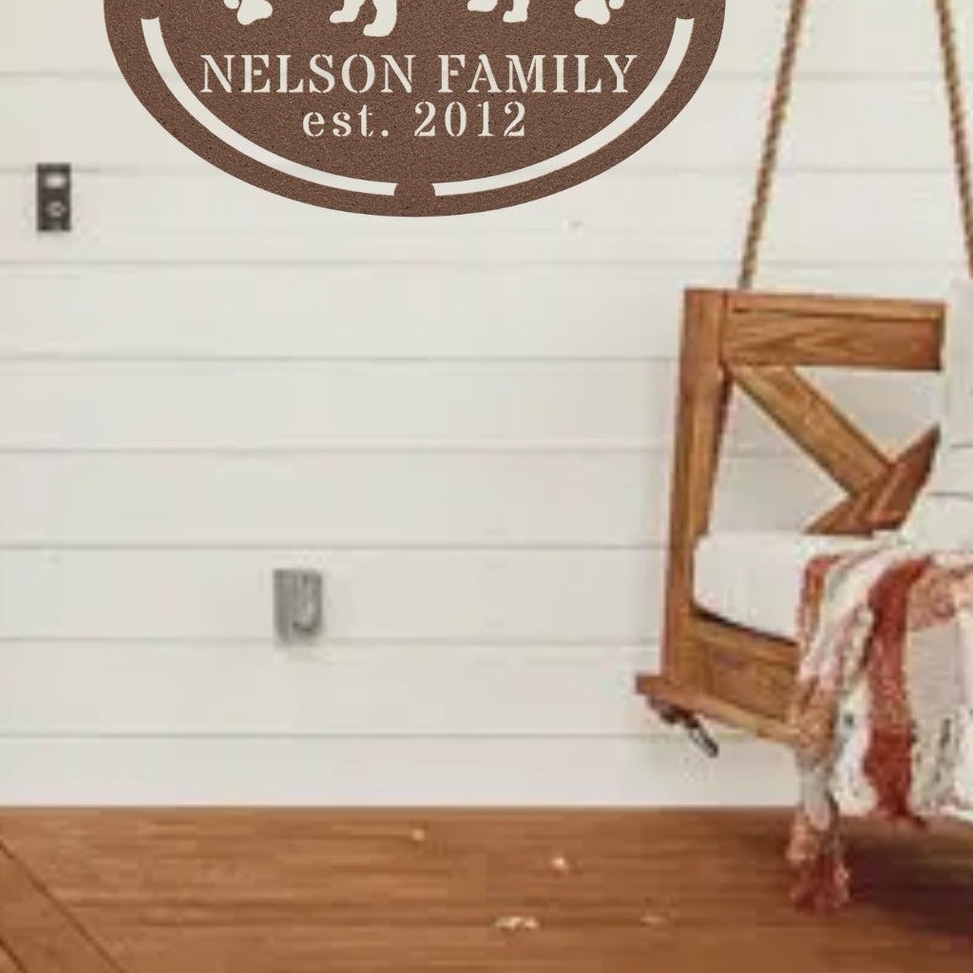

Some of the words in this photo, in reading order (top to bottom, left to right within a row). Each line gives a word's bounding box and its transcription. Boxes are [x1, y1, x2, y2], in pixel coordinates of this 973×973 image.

[200, 54, 416, 94] NELSON
[437, 53, 638, 94] FAMILY
[302, 104, 389, 138] est.
[414, 101, 527, 138] 2012
